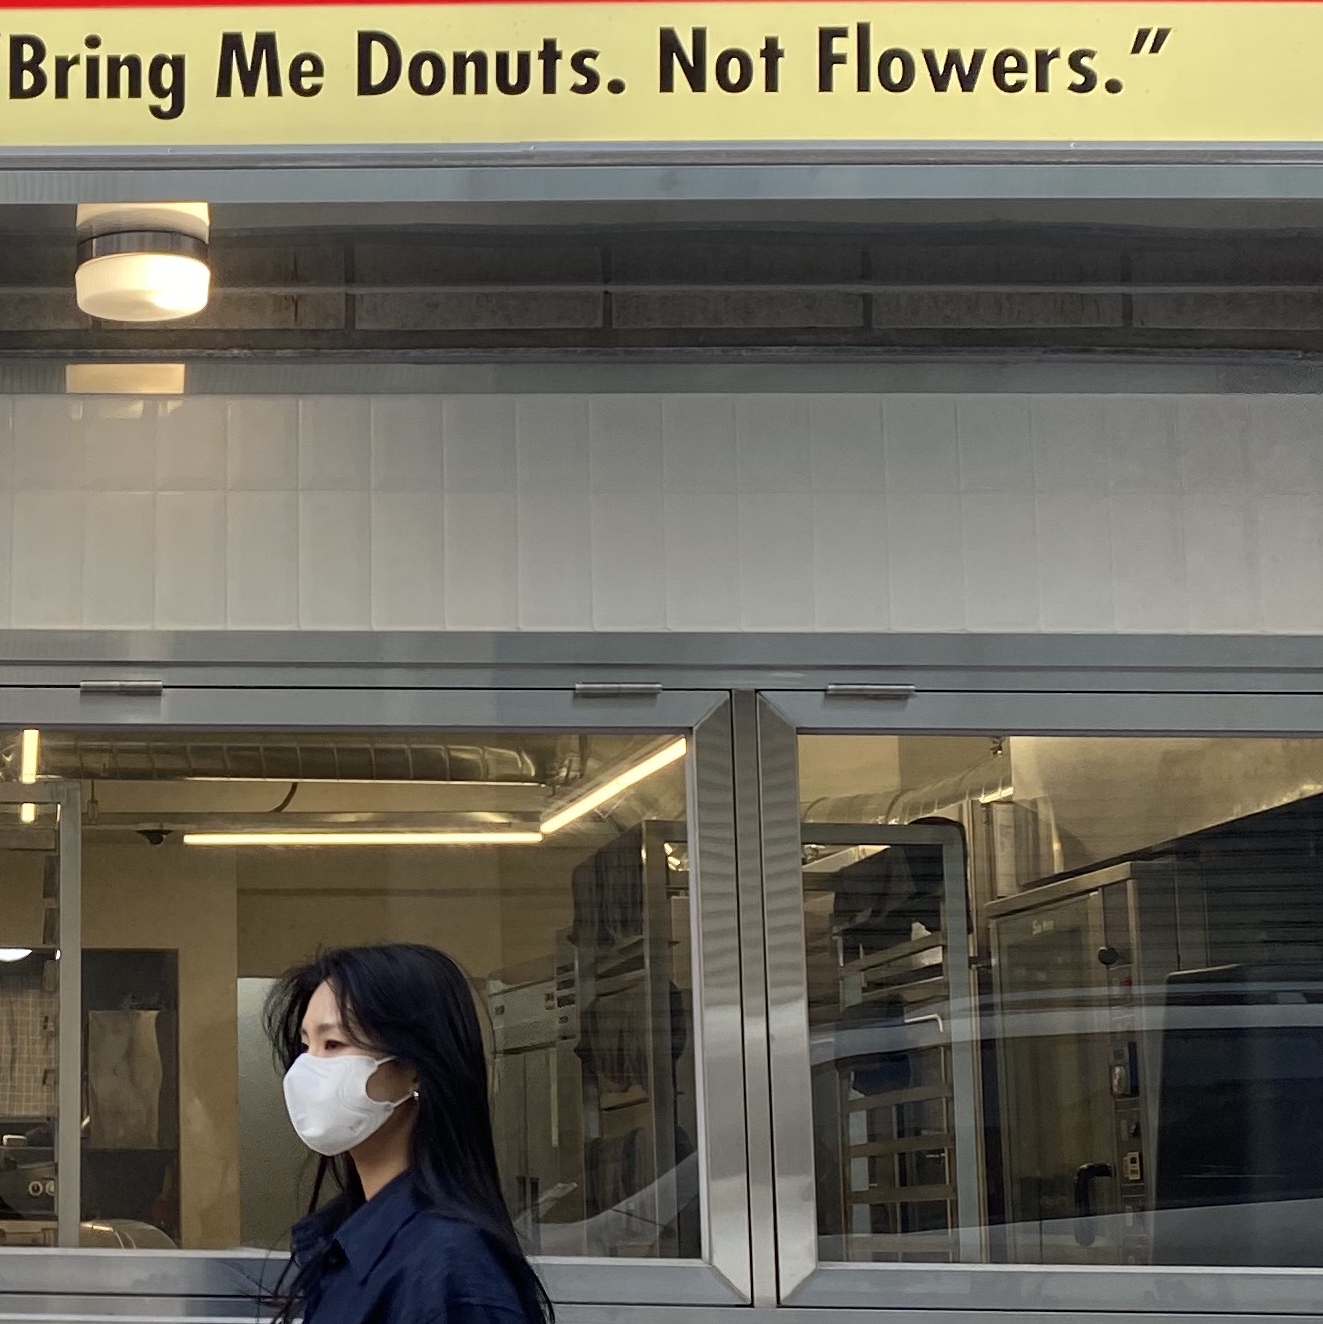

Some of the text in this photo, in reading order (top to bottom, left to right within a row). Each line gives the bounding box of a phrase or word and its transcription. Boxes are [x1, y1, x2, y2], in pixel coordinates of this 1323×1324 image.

[215, 31, 325, 98] Me
[356, 30, 626, 97] Donuts.
[659, 26, 785, 94] Not
[818, 22, 1172, 95] Flowers.”
